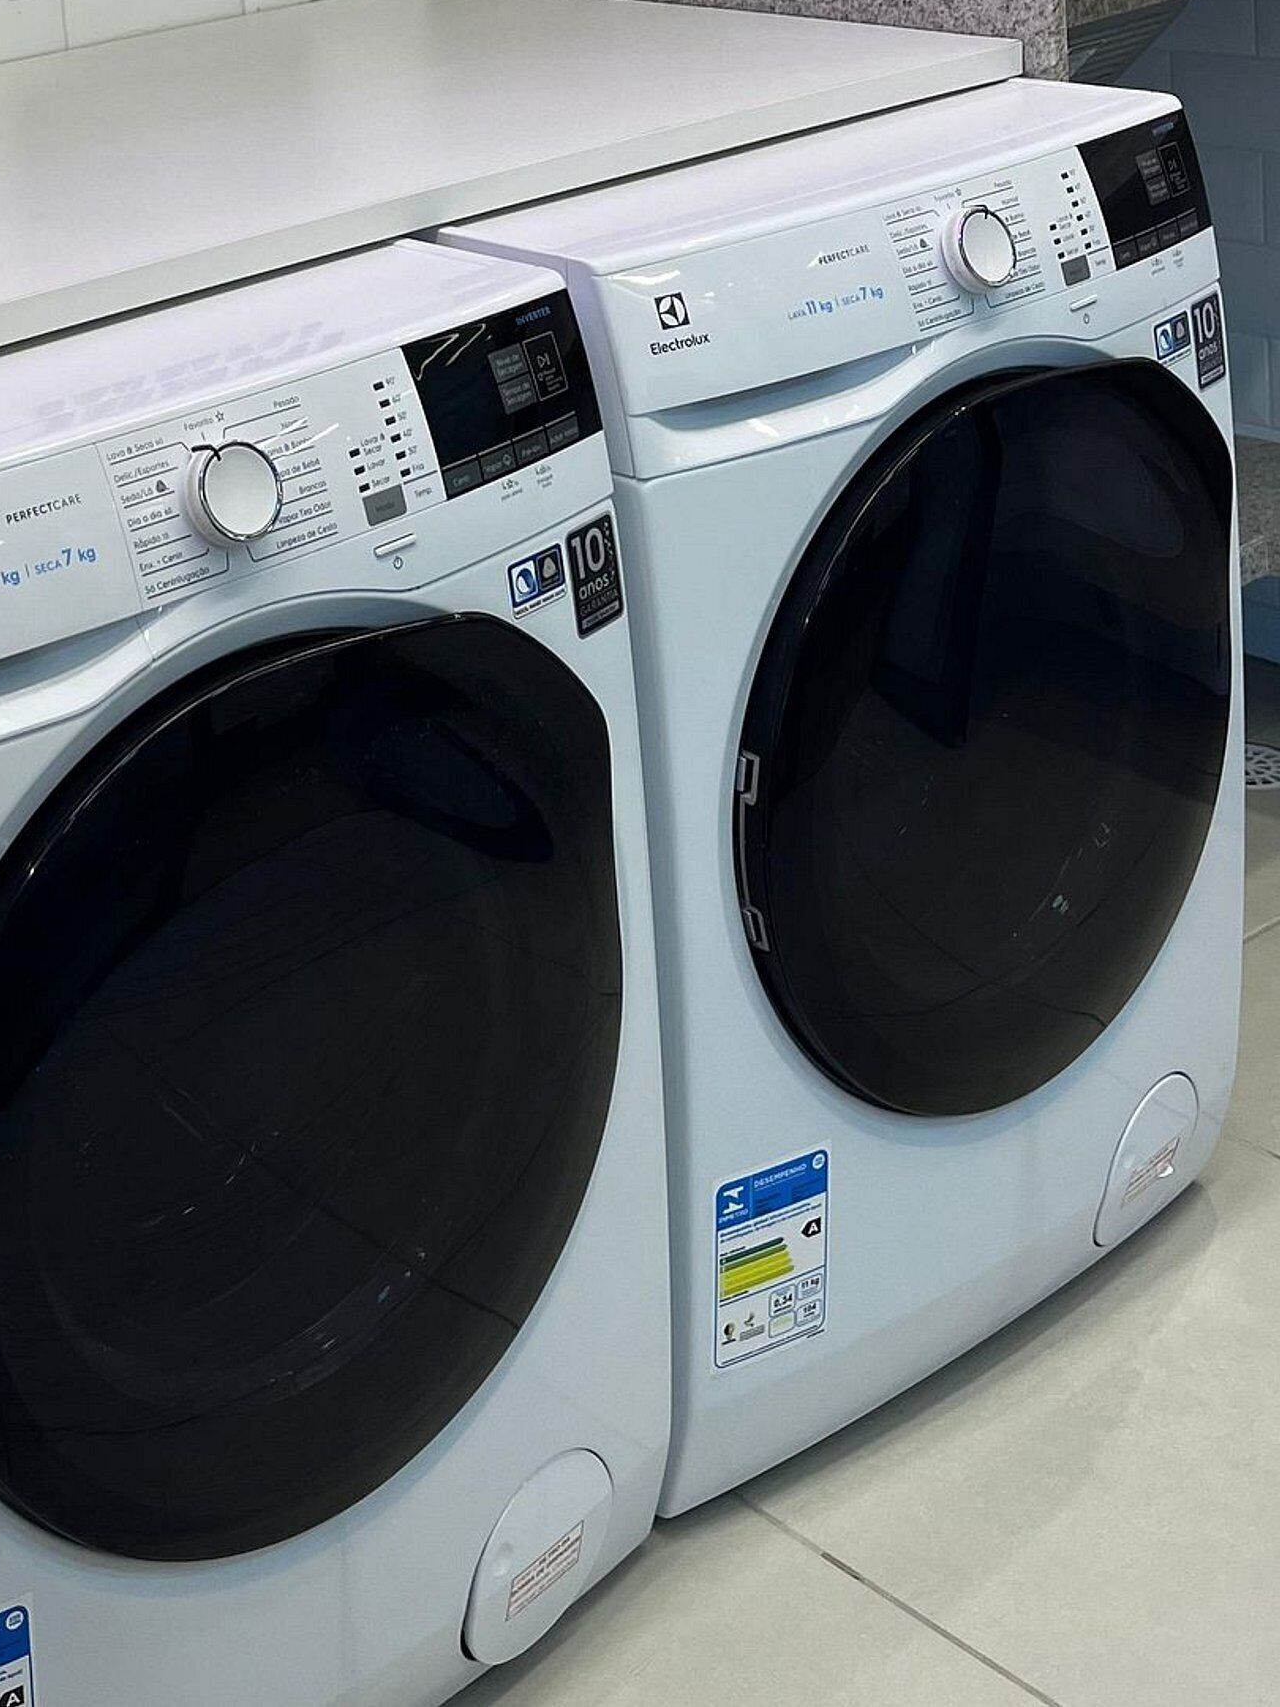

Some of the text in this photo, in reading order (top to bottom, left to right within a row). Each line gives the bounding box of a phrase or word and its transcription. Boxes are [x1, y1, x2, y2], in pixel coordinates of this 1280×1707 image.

[859, 287, 866, 300] 7
[1194, 302, 1215, 343] 10
[650, 333, 711, 356] Electrolux
[6, 494, 82, 524] PERFECTCARE
[0, 571, 20, 585] kg
[34, 560, 62, 575] SECA
[62, 548, 72, 566] 7
[78, 548, 96, 563] kg
[571, 528, 605, 579] 10
[579, 573, 609, 599] anos
[807, 1222, 819, 1234] A
[7, 1693, 19, 1706] A
